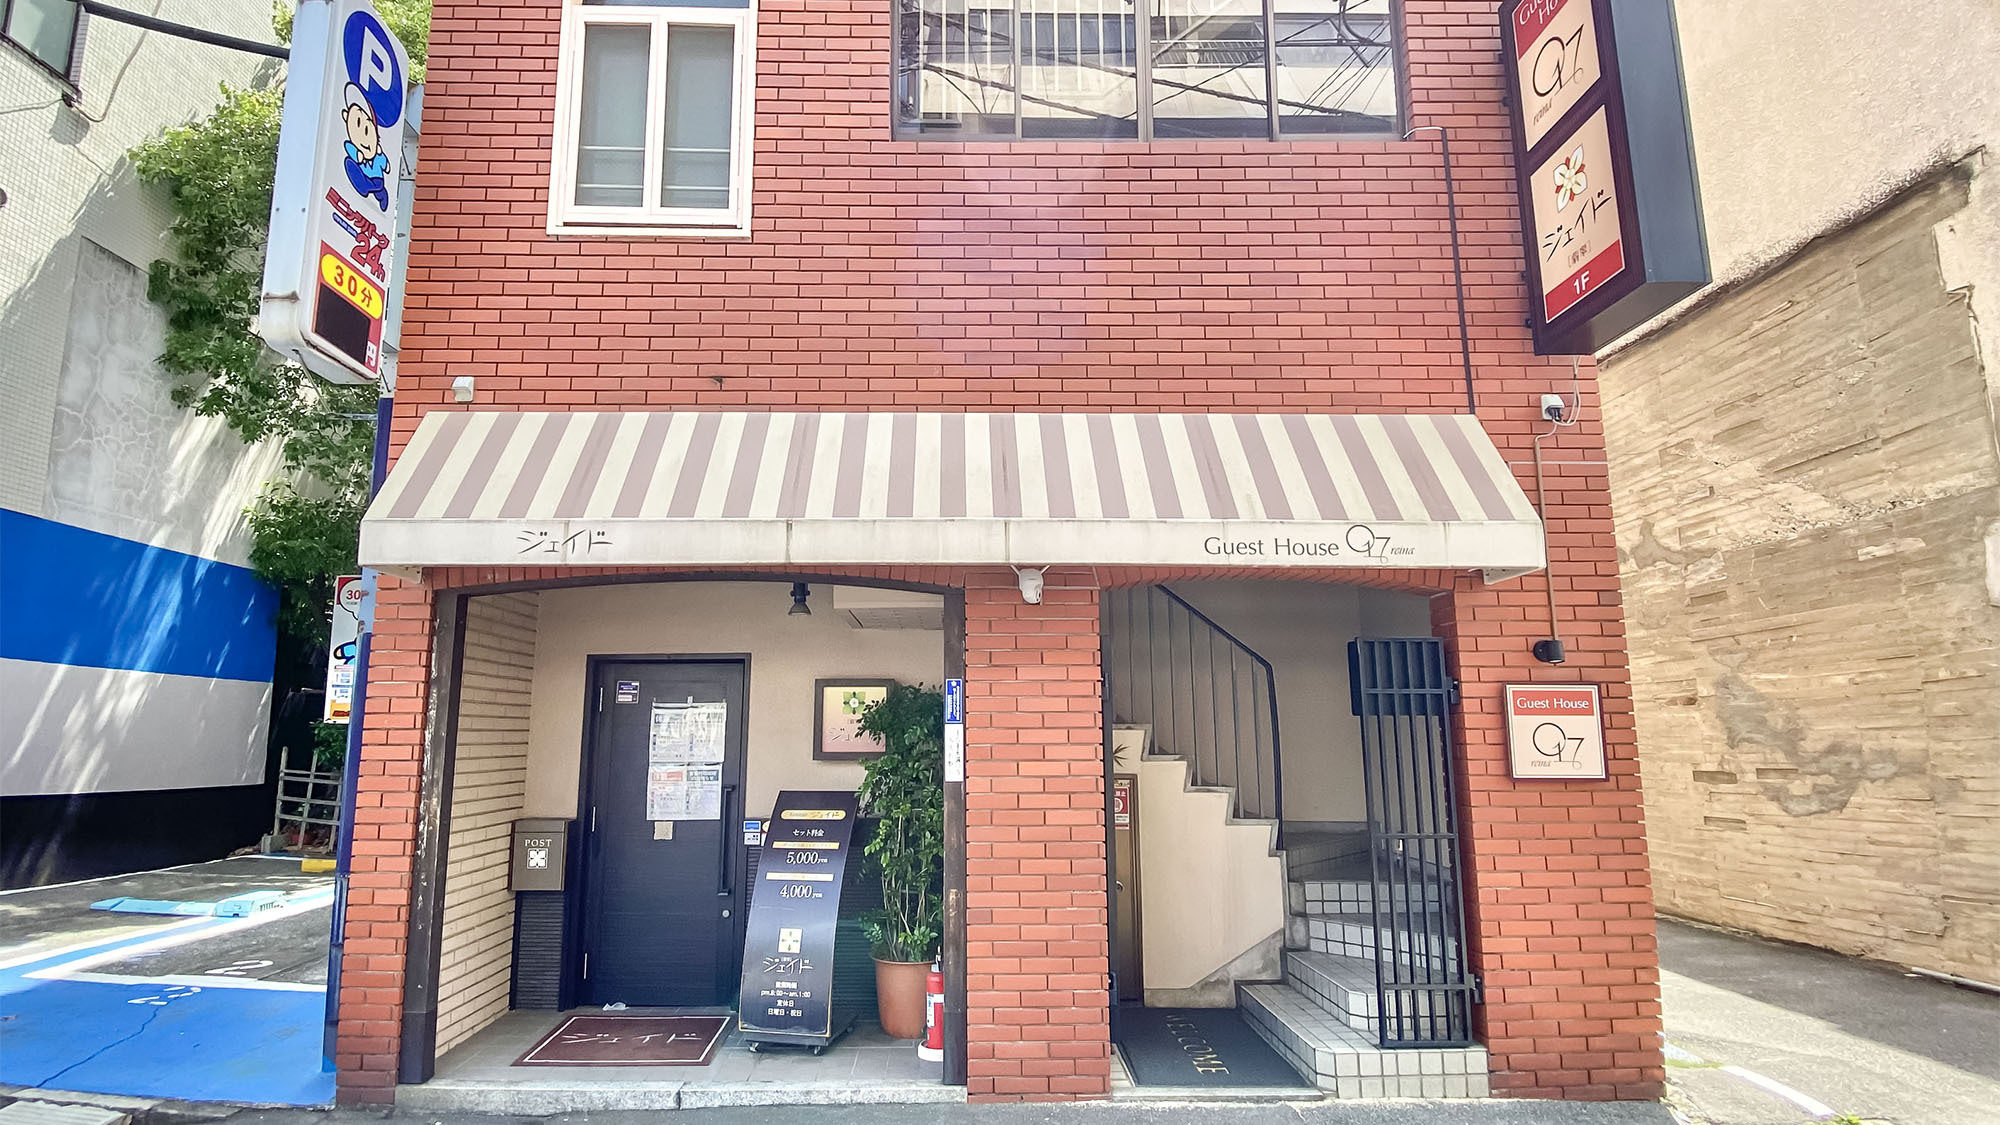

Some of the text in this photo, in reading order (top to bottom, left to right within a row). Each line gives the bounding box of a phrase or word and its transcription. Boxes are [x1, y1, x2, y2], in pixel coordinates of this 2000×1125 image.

[359, 26, 393, 94] P
[1542, 189, 1612, 263] ジェイド
[350, 232, 386, 283] 24h
[334, 265, 373, 308] 30分
[1573, 270, 1590, 295] 1F
[516, 529, 613, 555] ジェイド
[1204, 536, 1264, 555] Guest
[1274, 537, 1340, 556] House
[1516, 697, 1590, 709] Guest House
[792, 828, 825, 837] セット料金
[524, 839, 553, 847] POST
[204, 960, 274, 976] 2
[763, 955, 814, 975] ジェイド
[560, 1033, 702, 1044] ジェイド
